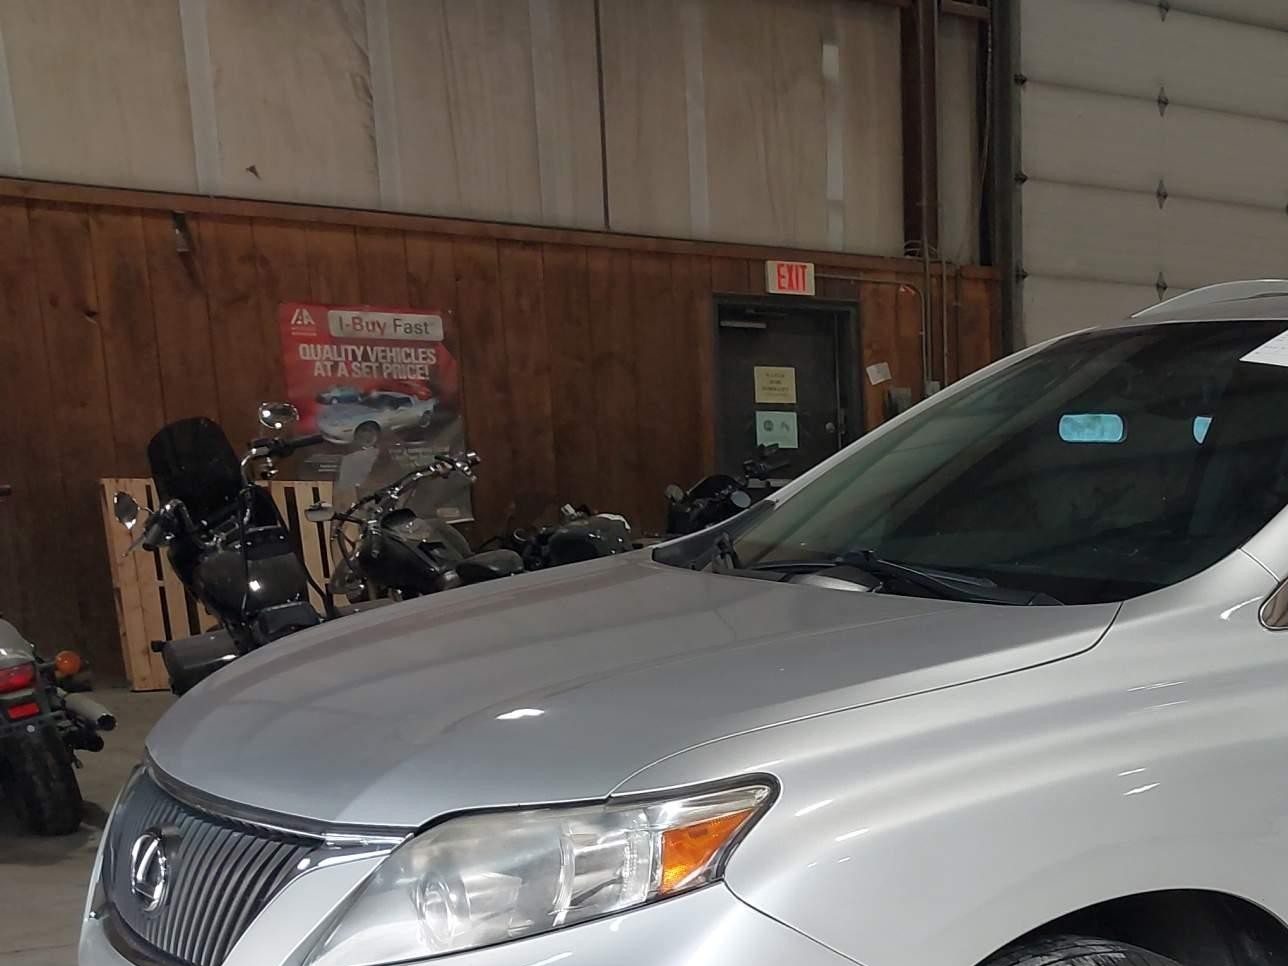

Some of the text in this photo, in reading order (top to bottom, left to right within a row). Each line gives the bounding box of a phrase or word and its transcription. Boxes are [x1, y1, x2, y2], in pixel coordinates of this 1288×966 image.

[777, 263, 807, 291] EXIT
[339, 315, 430, 335] I-Buy Fast
[299, 344, 437, 364] QUALITY VEHICLES
[313, 361, 431, 380] AT A SET PRICE!
